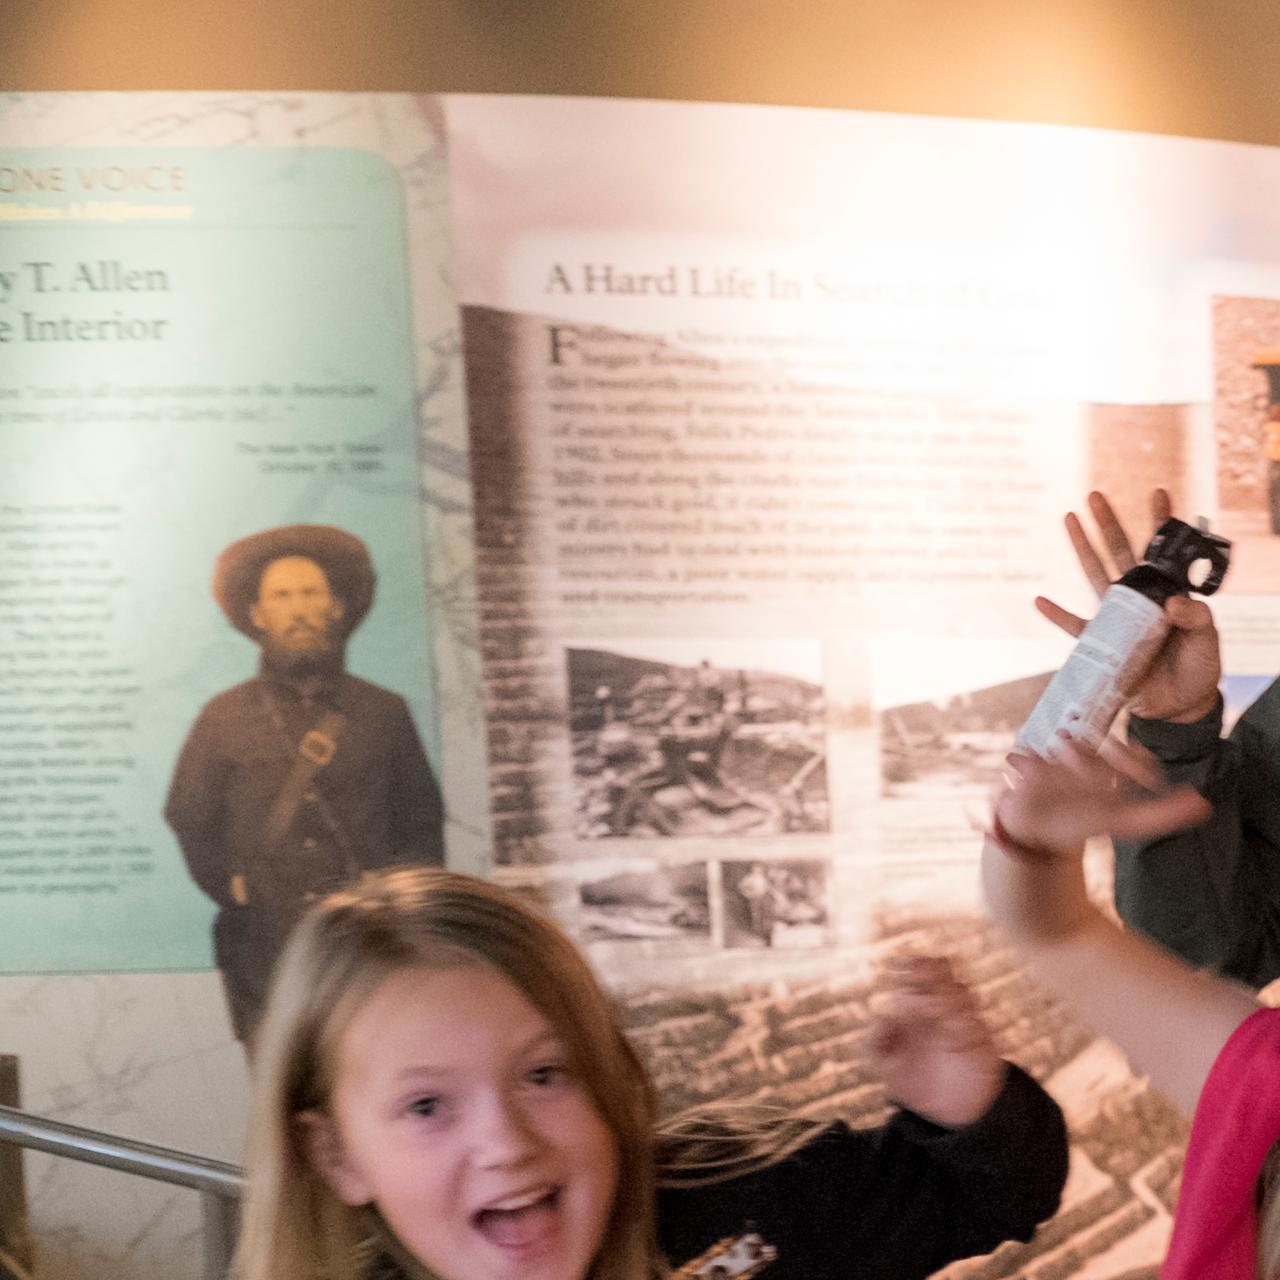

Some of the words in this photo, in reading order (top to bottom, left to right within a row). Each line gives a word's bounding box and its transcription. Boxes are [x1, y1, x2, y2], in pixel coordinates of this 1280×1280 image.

[75, 165, 185, 192] VOICE
[21, 260, 62, 293] T.
[70, 259, 171, 292] Allen
[545, 263, 573, 296] A
[583, 263, 677, 297] Hard
[690, 266, 757, 299] Life
[768, 269, 803, 301] In
[20, 310, 168, 342] Interior
